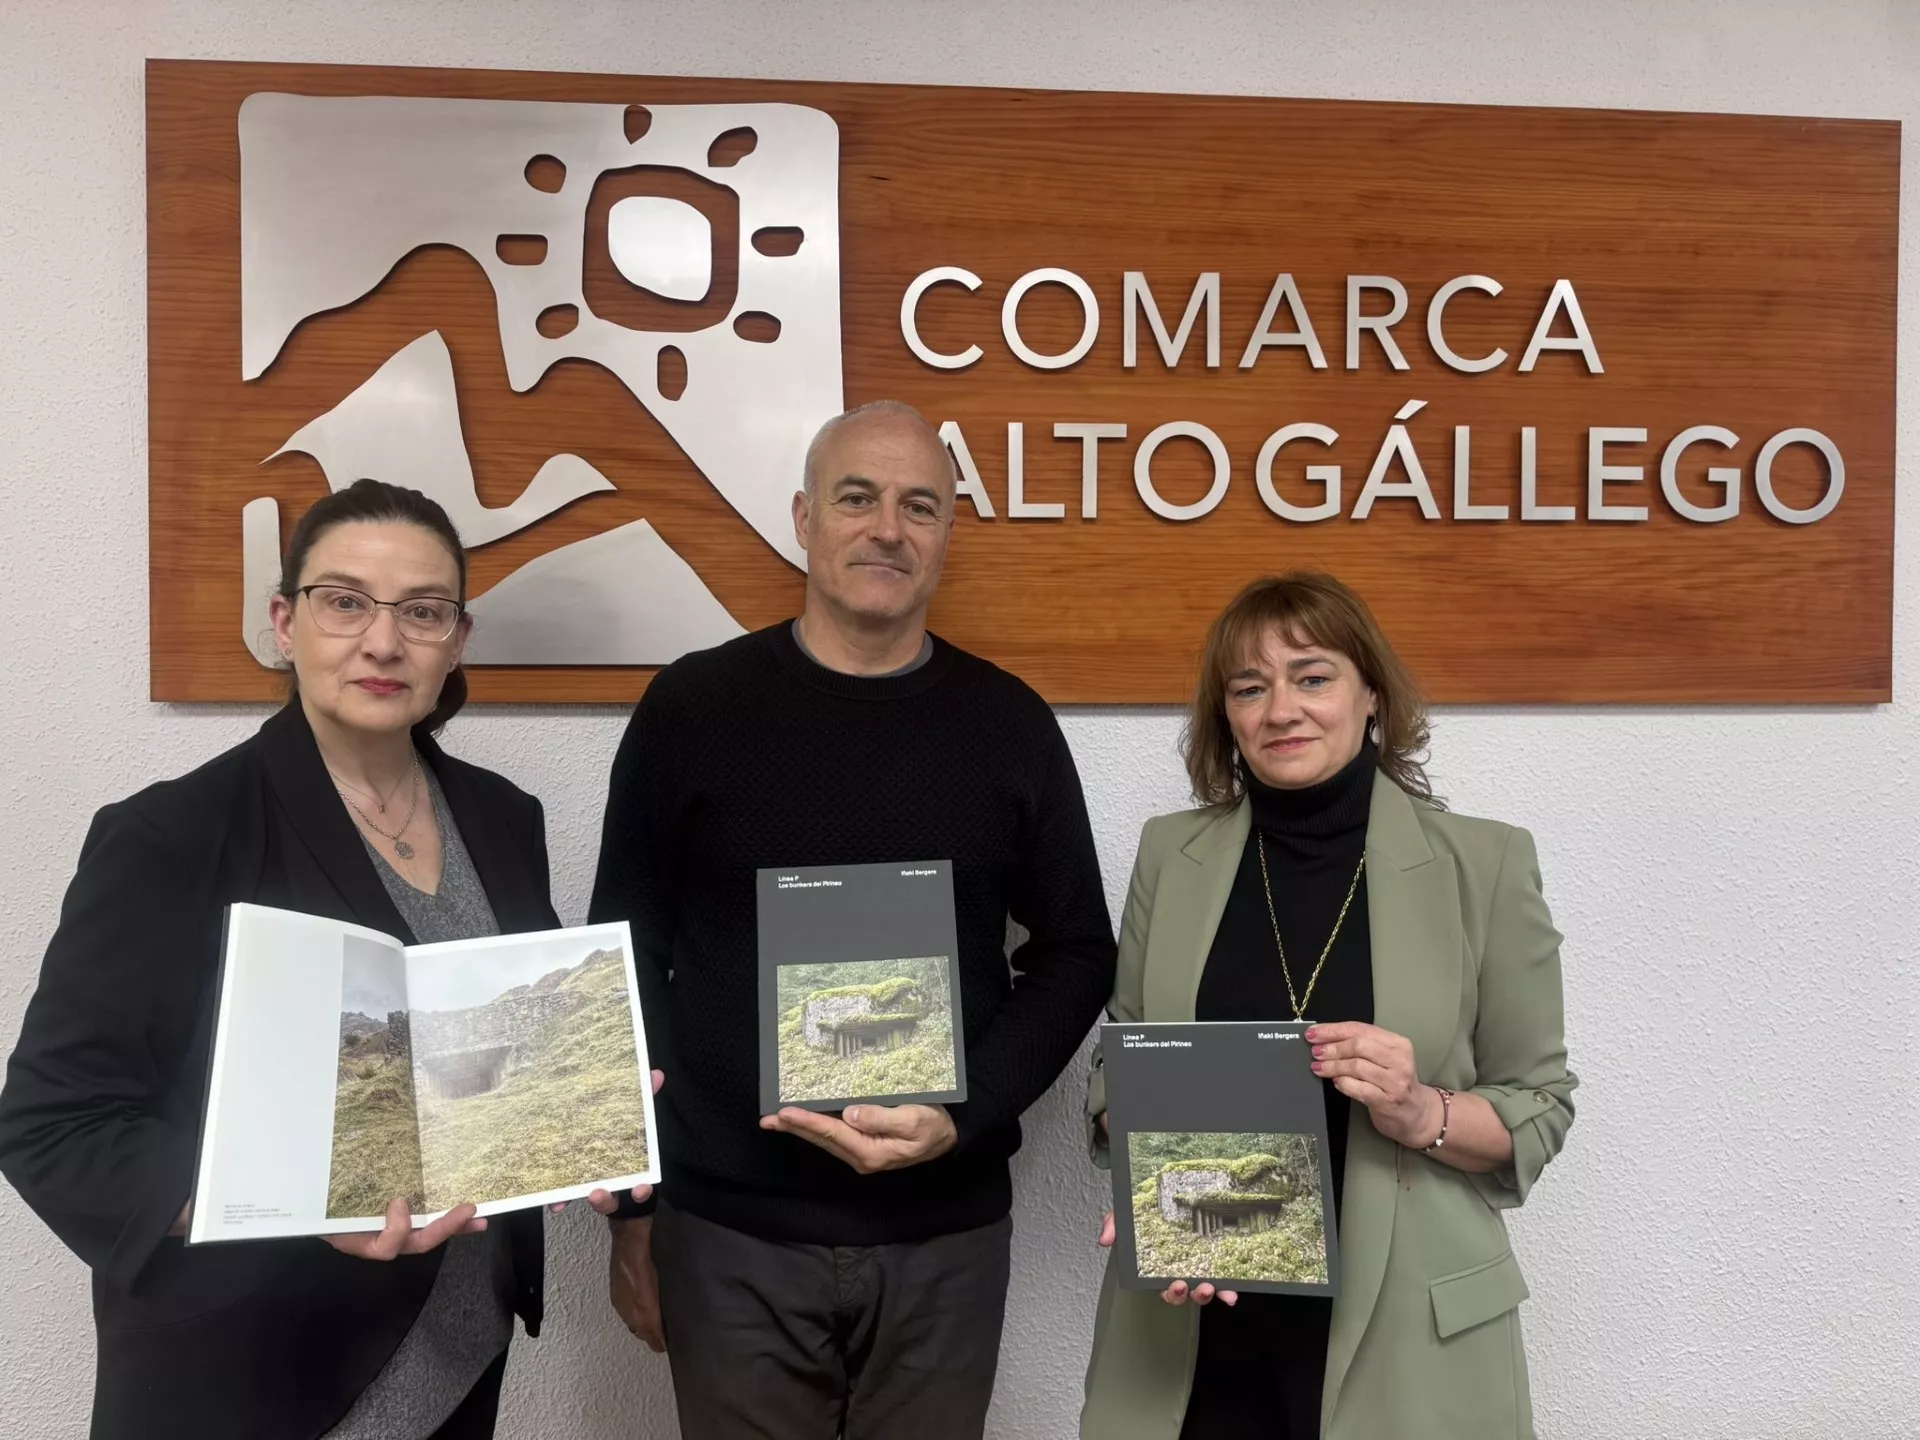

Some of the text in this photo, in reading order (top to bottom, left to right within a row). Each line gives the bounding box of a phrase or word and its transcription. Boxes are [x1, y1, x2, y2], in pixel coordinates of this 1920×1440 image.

[899, 266, 1605, 374] COMARCA
[938, 399, 1846, 524] ALTO GÁLLEGO
